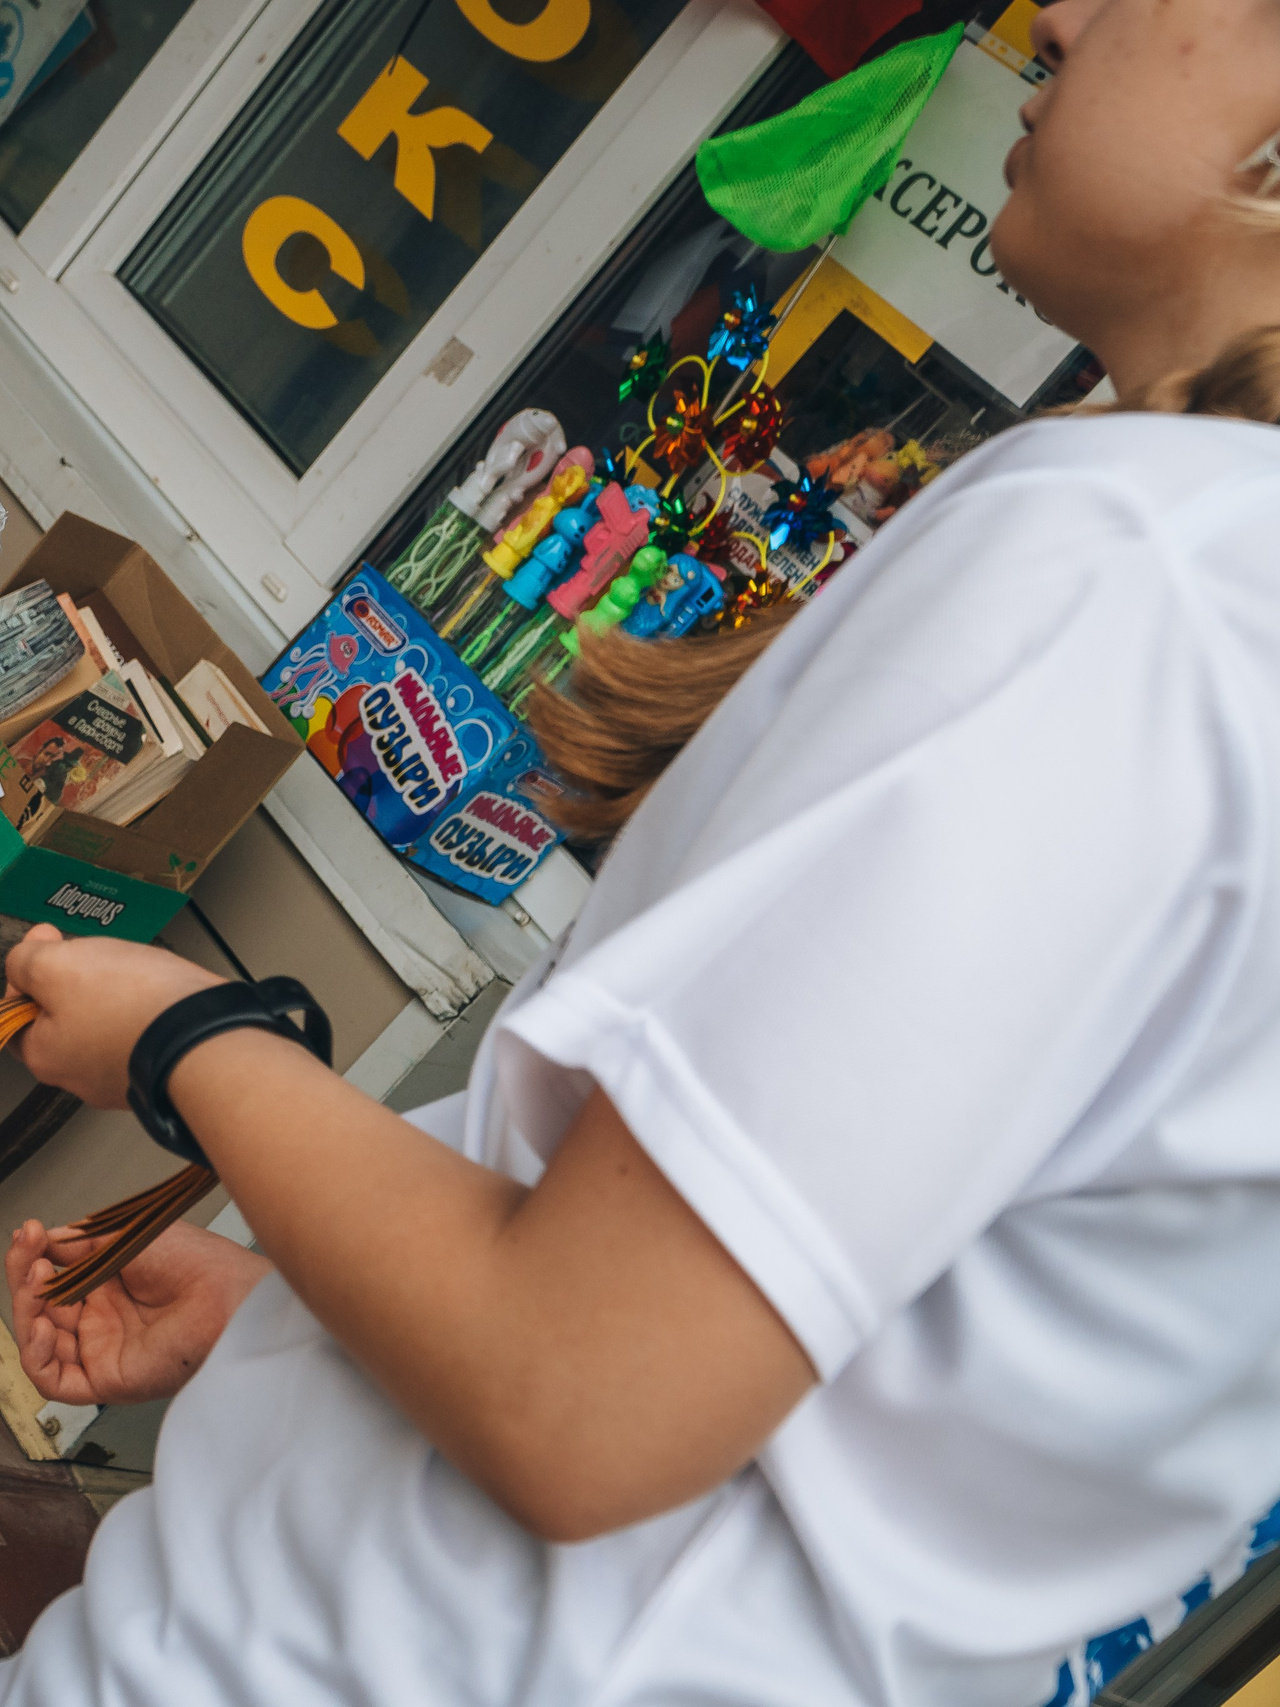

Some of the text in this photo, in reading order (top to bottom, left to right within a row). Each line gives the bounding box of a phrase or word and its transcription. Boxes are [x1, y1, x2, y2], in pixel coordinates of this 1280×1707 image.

[872, 156, 1056, 327] СЕРО
[363, 685, 442, 810] ПУЗЫРИ
[394, 671, 464, 785] МЫЛЬНЫЕ
[434, 816, 533, 881] ПУЗЫРИ
[465, 795, 554, 852] МЫЛЬНЫЕ
[46, 883, 125, 926] SvetoCopy
[85, 879, 119, 896] CLASSIC
